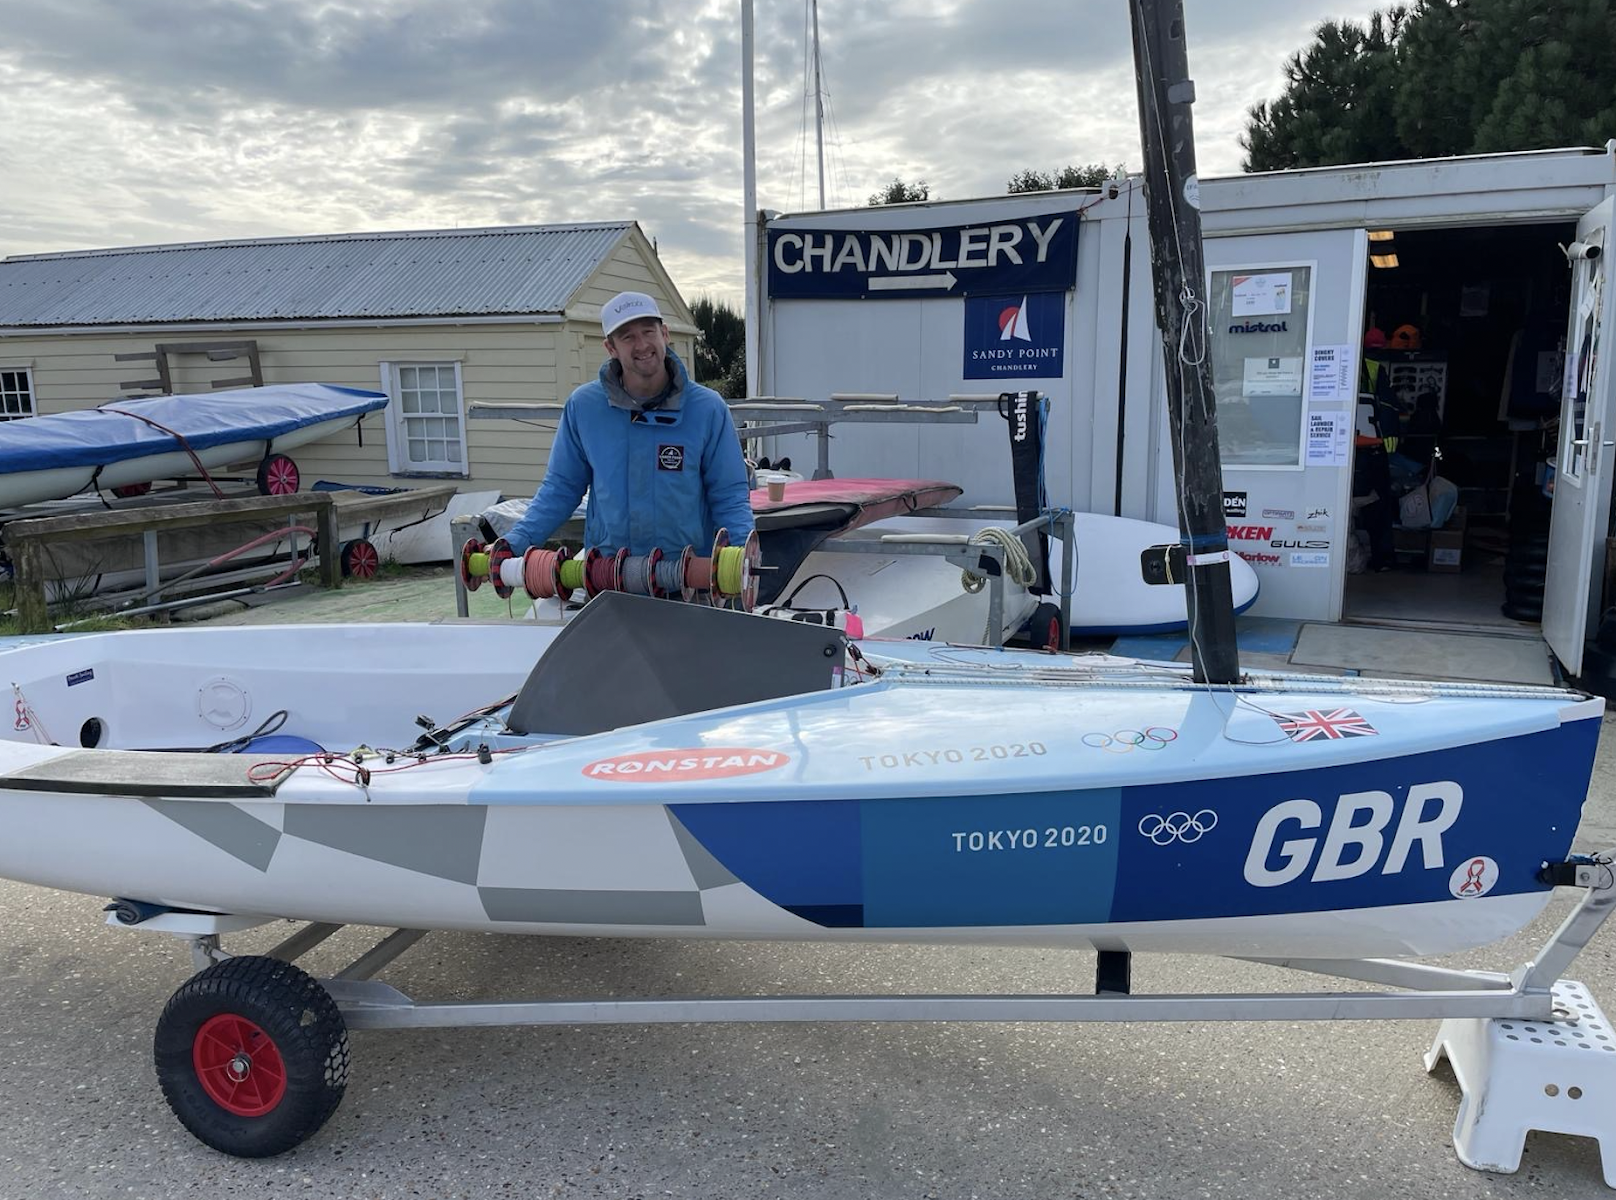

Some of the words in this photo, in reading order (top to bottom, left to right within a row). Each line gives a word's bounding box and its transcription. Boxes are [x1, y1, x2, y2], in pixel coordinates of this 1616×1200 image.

[773, 218, 1064, 274] CHANDLERY
[1229, 321, 1288, 333] mistral
[972, 349, 1014, 360] SANDY
[1019, 347, 1058, 358] POINT
[1307, 508, 1330, 519] zhik
[590, 754, 778, 775] RONSTAN
[858, 749, 964, 771] TOKYO
[969, 742, 1048, 761] 2020
[952, 829, 1038, 852] TOKYO
[1044, 824, 1107, 848] 2020
[1243, 780, 1464, 888] GBR
